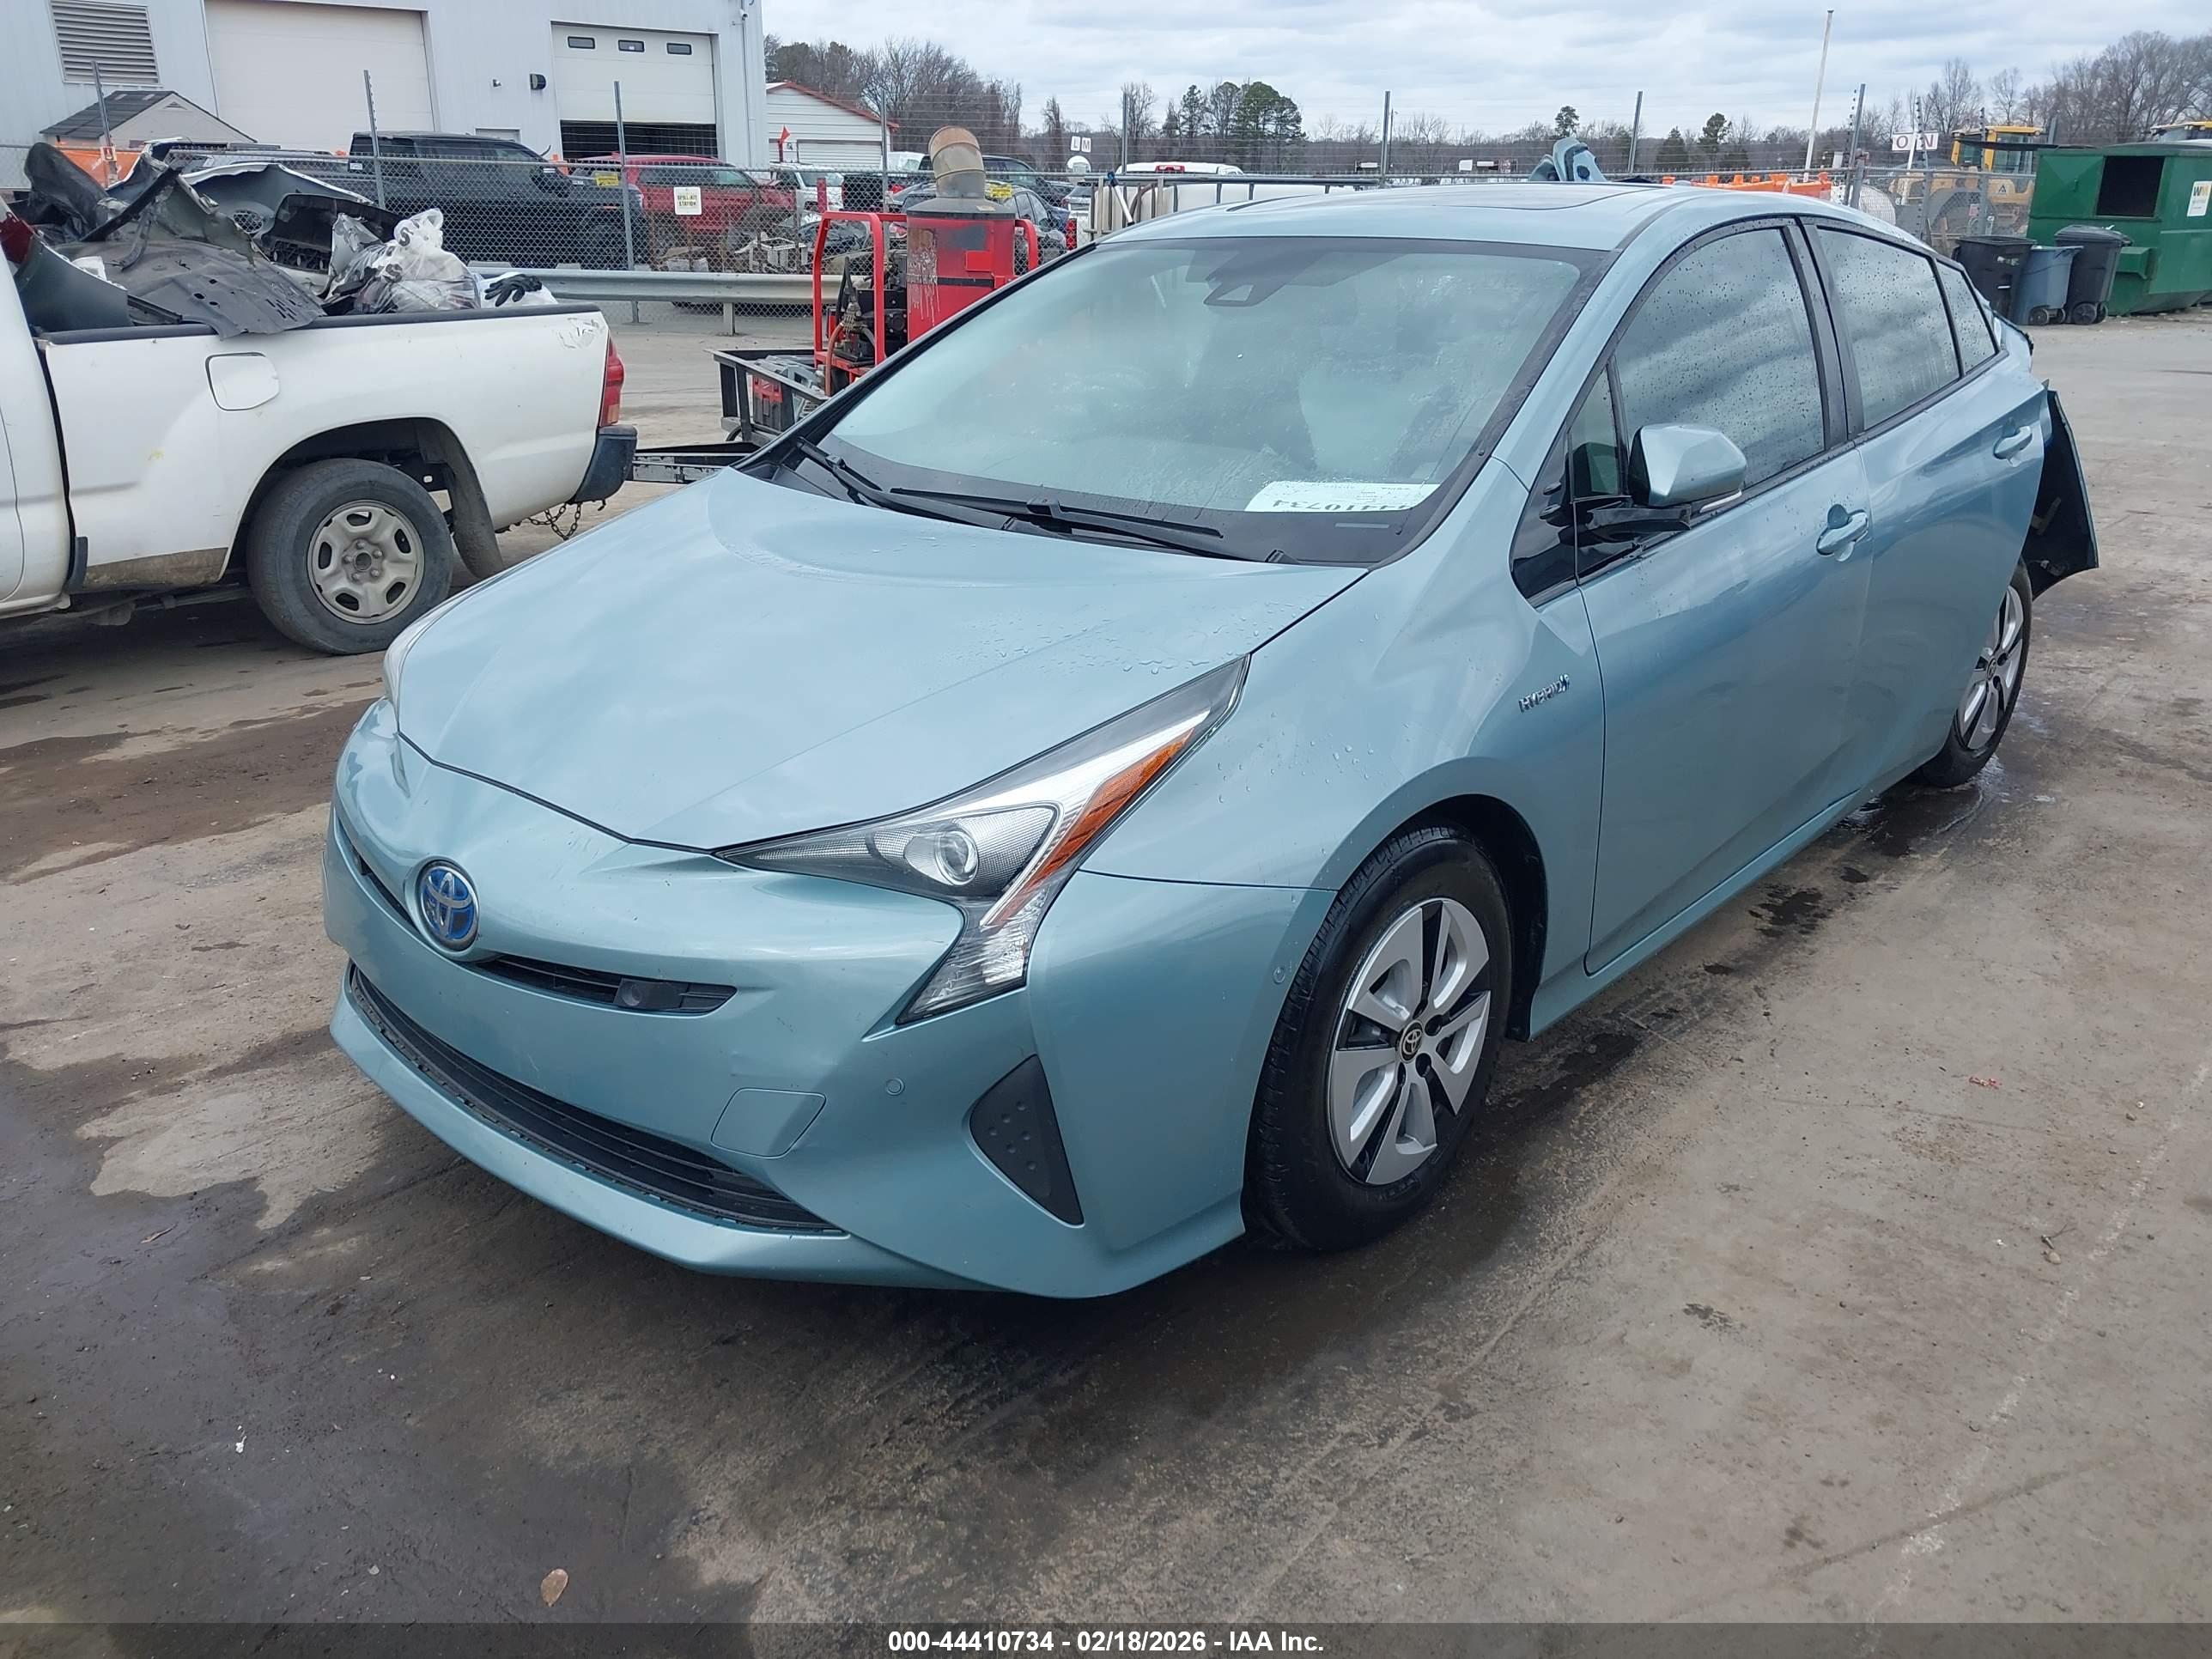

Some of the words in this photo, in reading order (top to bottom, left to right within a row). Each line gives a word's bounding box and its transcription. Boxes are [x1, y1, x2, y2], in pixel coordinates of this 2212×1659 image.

[1083, 139, 1091, 150] M
[1896, 135, 1909, 149] O
[1518, 675, 1569, 713] HYBRID
